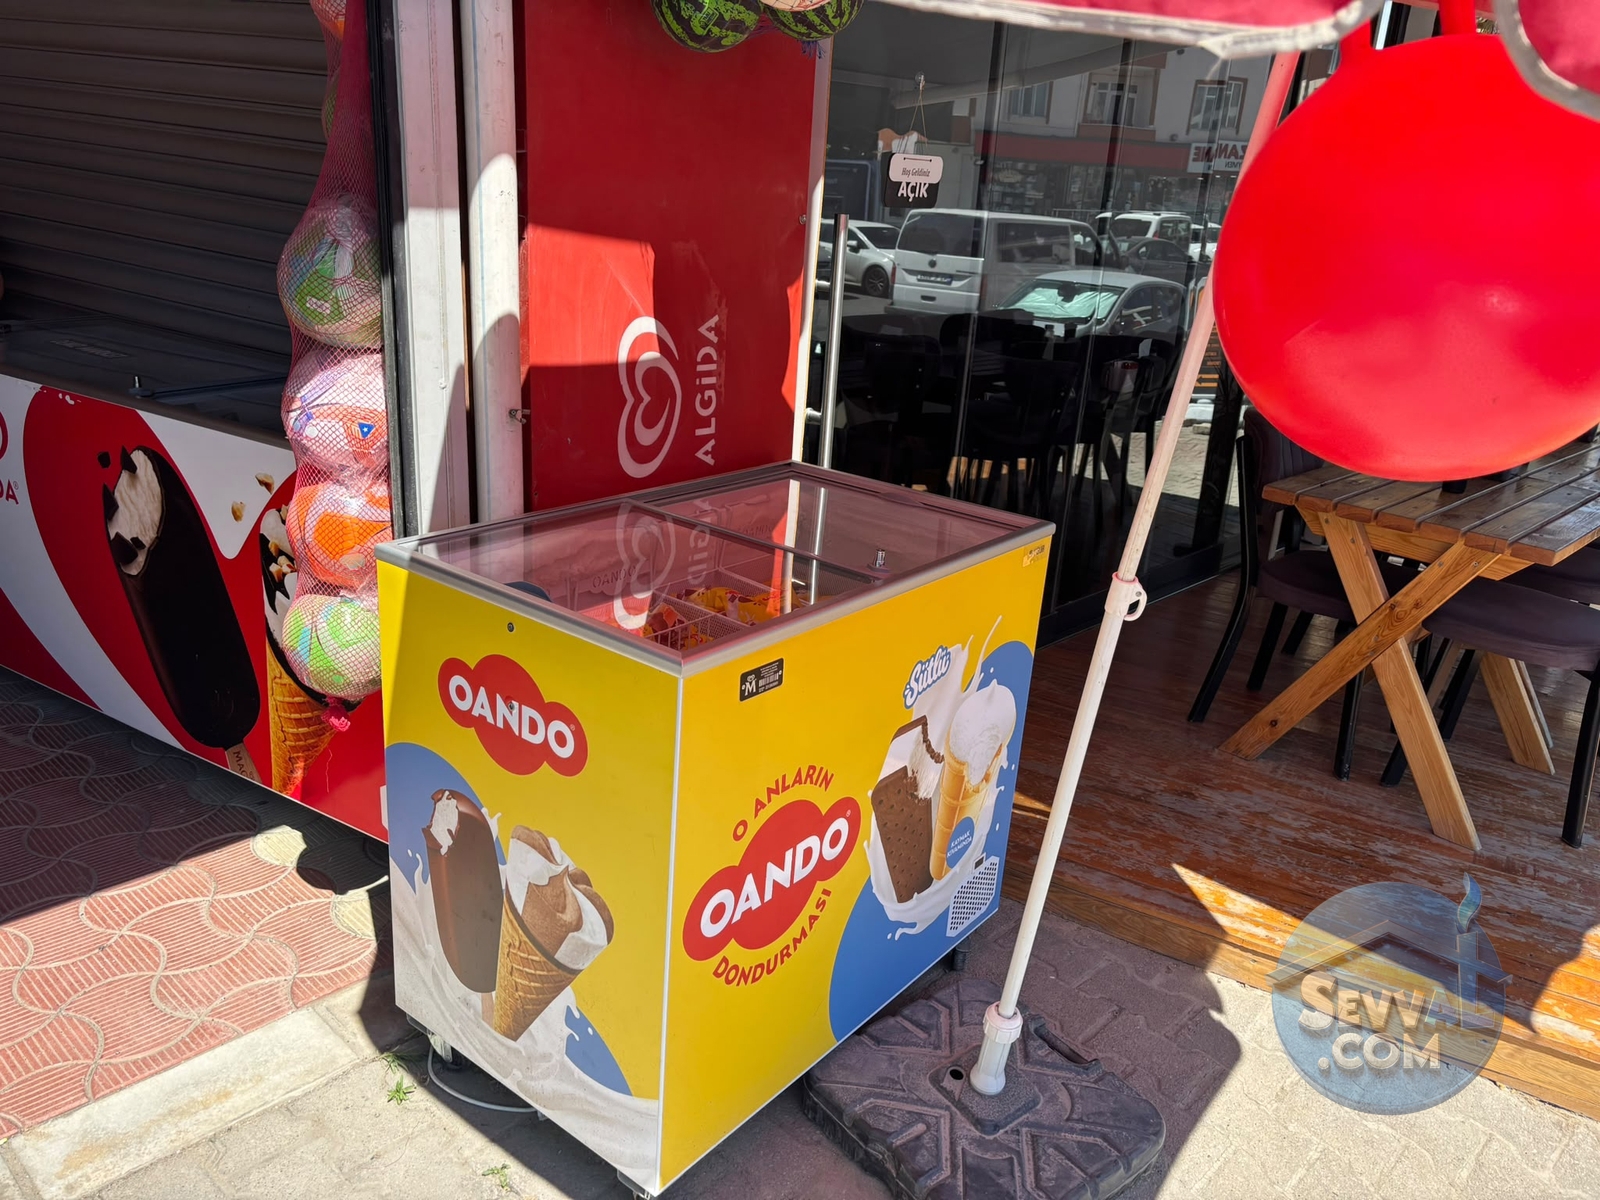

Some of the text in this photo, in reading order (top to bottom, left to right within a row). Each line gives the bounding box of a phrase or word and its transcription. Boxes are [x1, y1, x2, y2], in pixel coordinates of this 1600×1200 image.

[897, 181, 929, 202] AÇIK
[448, 674, 575, 758] OANDO
[904, 648, 949, 706] Sütlü
[732, 764, 834, 842] O ANLARIN
[700, 817, 849, 938] OANDO
[712, 888, 832, 987] DONDURMASI
